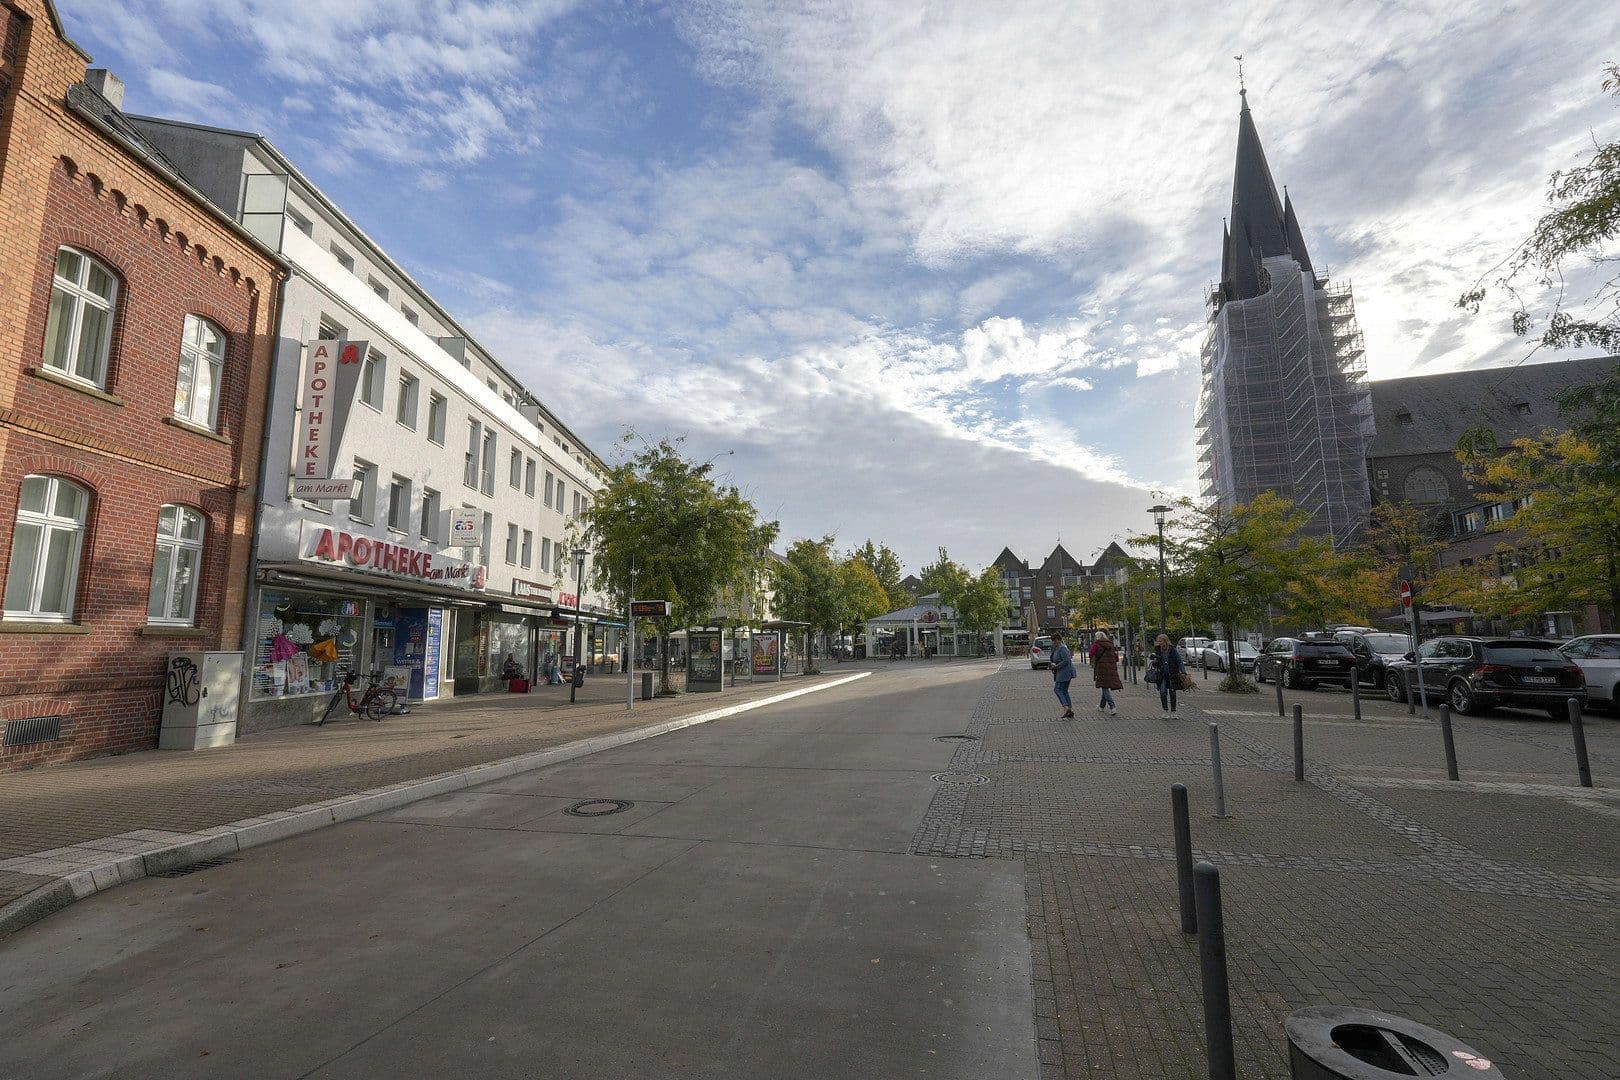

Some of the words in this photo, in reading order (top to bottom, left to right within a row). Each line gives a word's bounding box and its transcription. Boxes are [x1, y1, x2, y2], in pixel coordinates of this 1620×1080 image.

[304, 345, 329, 476] APOTHEKE
[296, 484, 313, 493] am
[315, 483, 349, 493] Markt
[315, 528, 432, 578] APOTHEKE
[429, 568, 443, 580] am
[444, 563, 470, 579] Markt
